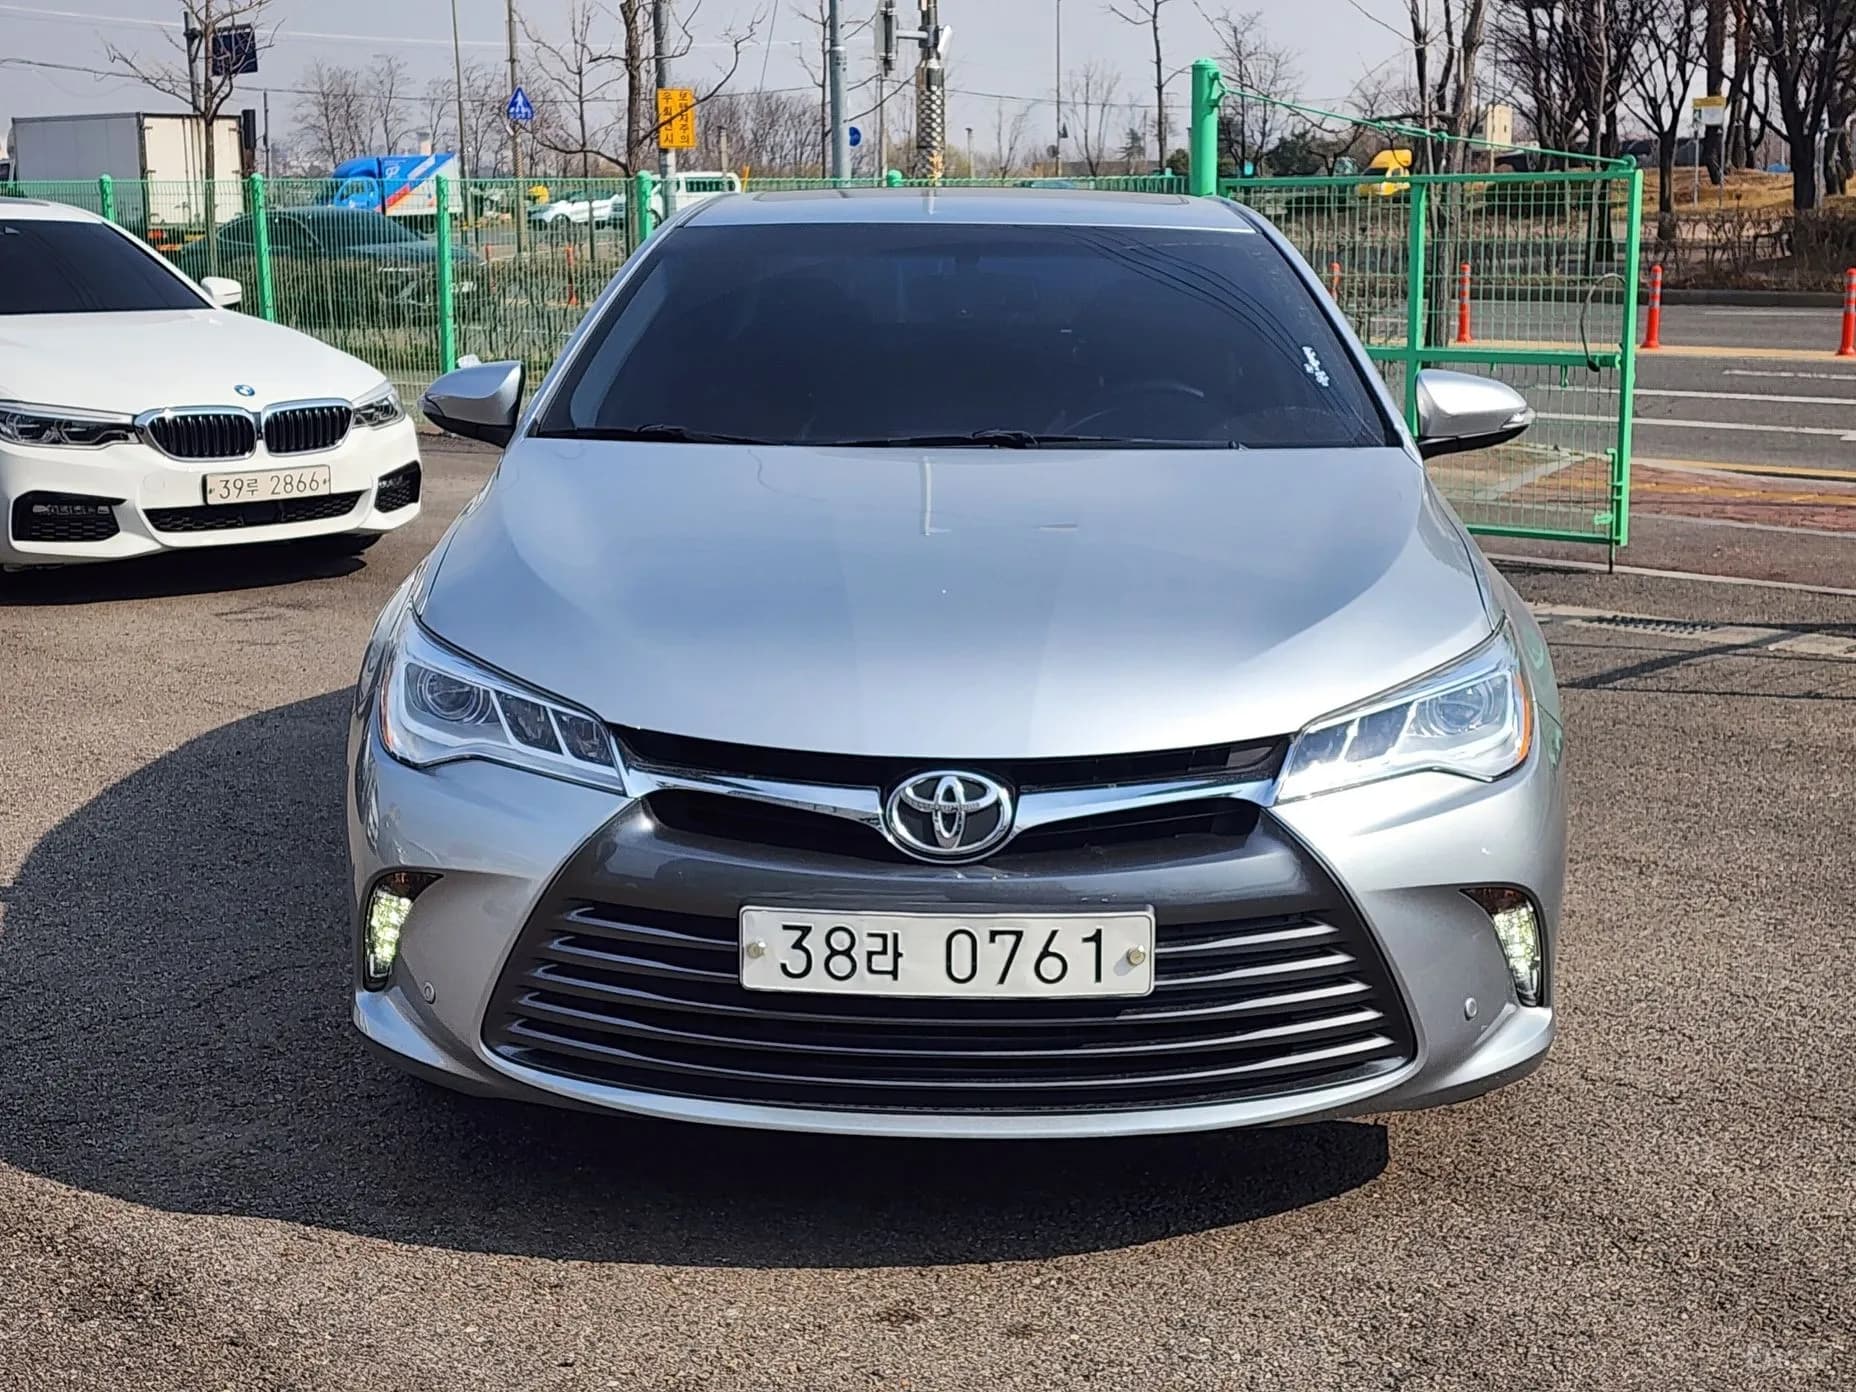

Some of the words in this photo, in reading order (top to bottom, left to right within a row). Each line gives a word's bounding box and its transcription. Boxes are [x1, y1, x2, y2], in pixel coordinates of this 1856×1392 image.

[219, 478, 259, 500] 39루
[269, 471, 320, 496] 2866
[779, 924, 904, 981] 38라
[945, 927, 1104, 985] 0761
